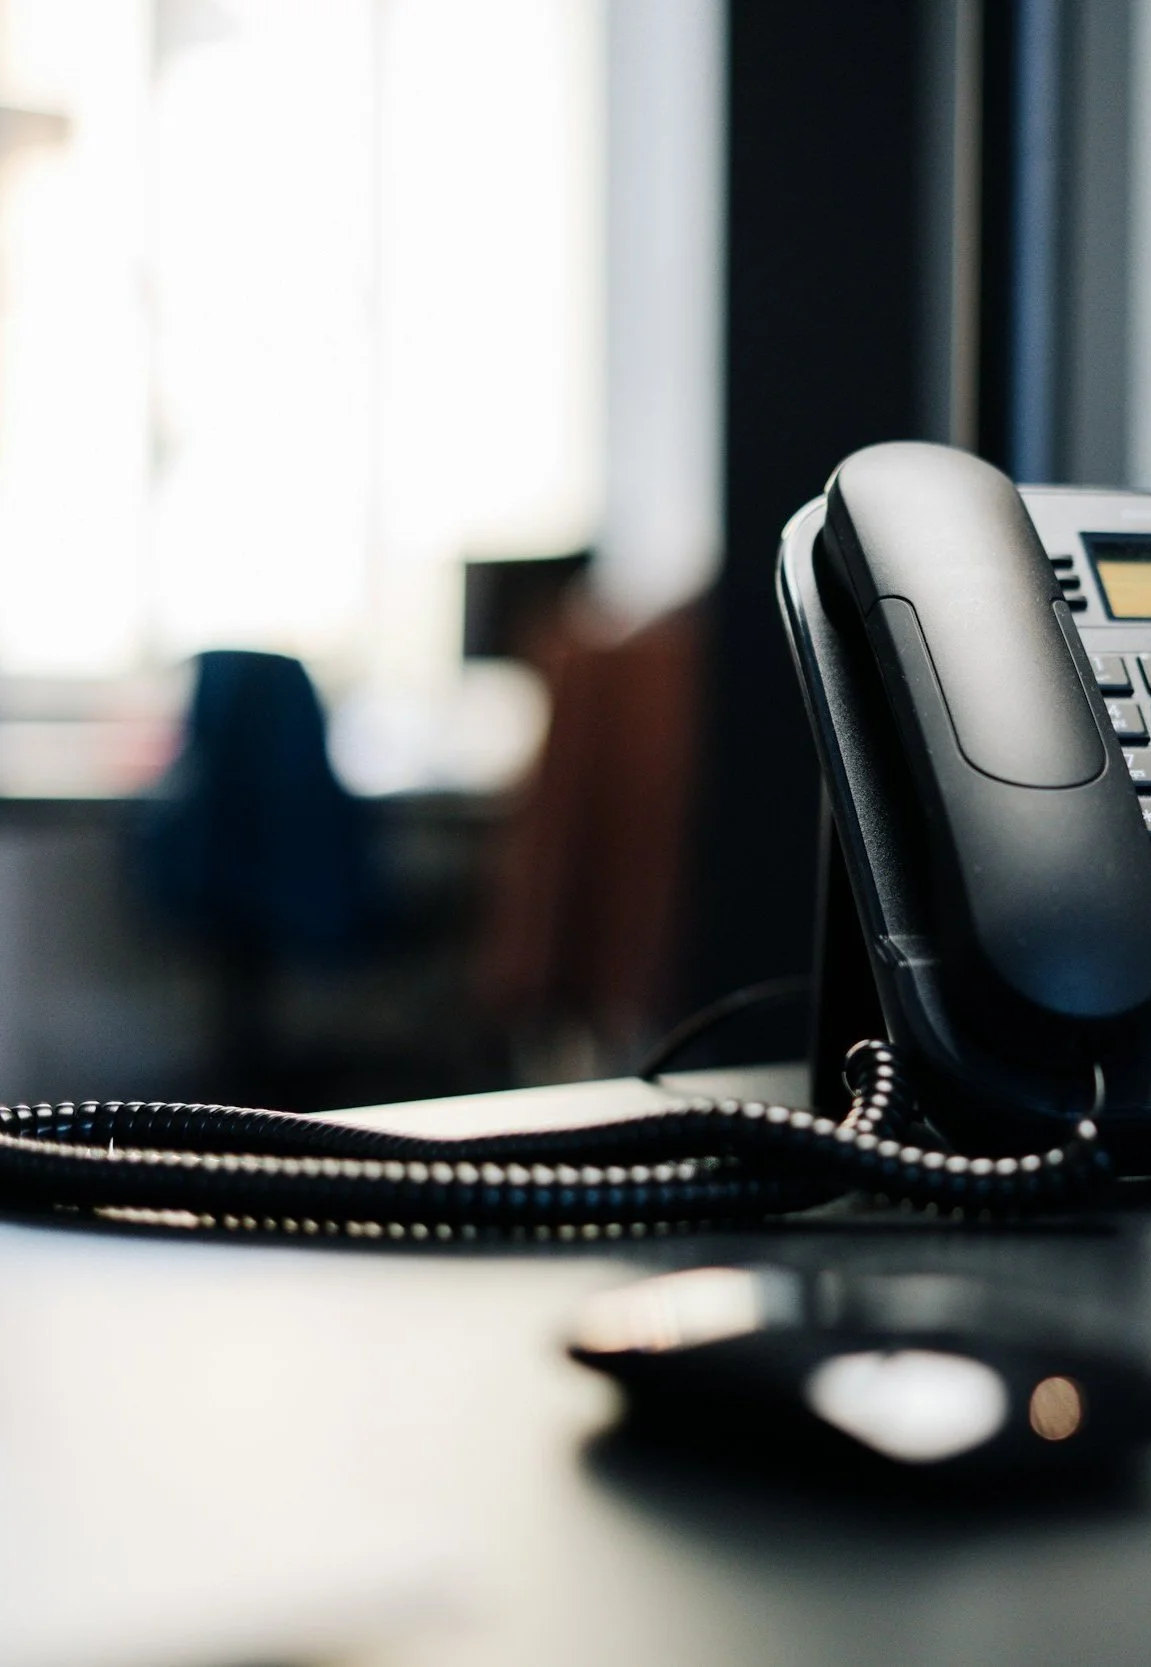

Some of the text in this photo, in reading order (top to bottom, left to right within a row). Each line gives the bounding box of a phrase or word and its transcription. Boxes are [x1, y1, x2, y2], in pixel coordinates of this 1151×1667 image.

[1093, 657, 1105, 671] 1
[1108, 704, 1122, 718] 4
[1123, 754, 1135, 768] 7
